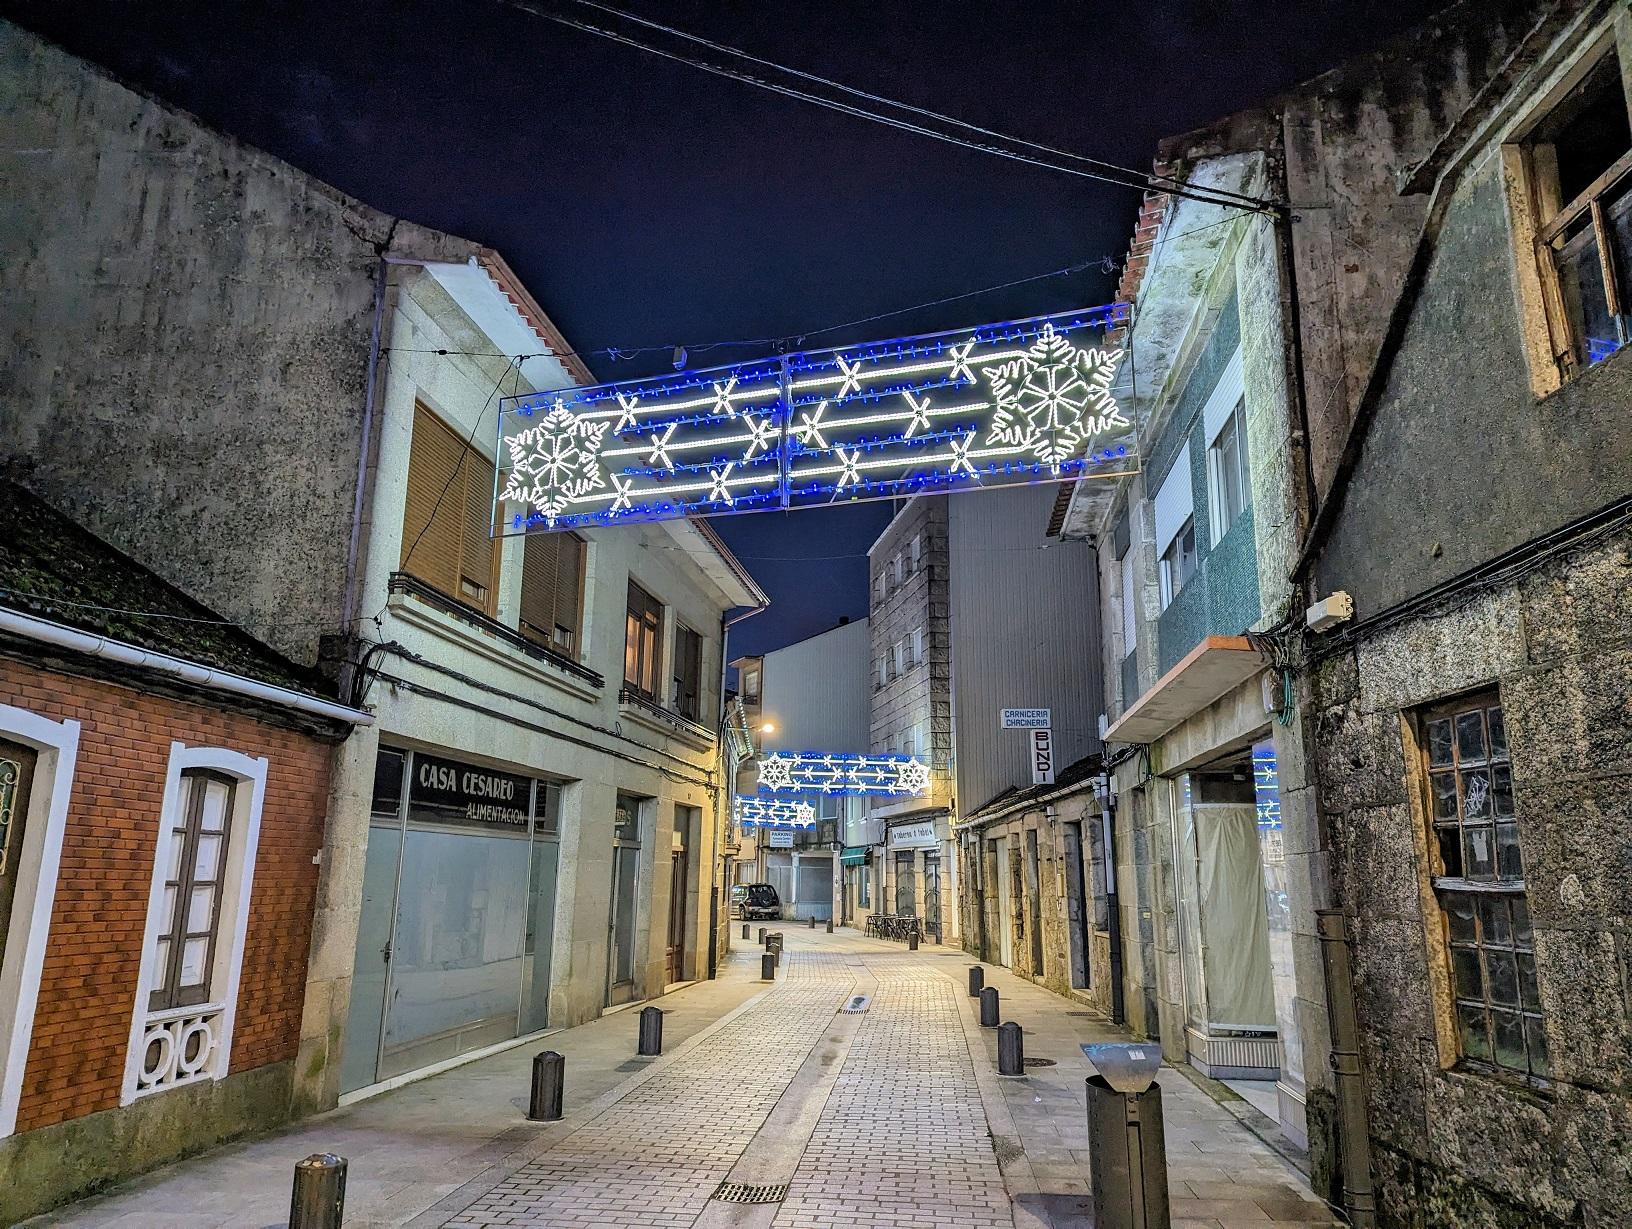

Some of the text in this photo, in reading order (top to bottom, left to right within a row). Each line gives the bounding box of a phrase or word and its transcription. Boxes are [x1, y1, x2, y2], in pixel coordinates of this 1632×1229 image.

[1004, 710, 1048, 718] CARNICERIA
[1006, 719, 1048, 727] CHACINERIA
[1035, 731, 1051, 782] BUNDI
[420, 763, 514, 800] CASA CESAREO
[465, 802, 525, 824] ALIMENTACION
